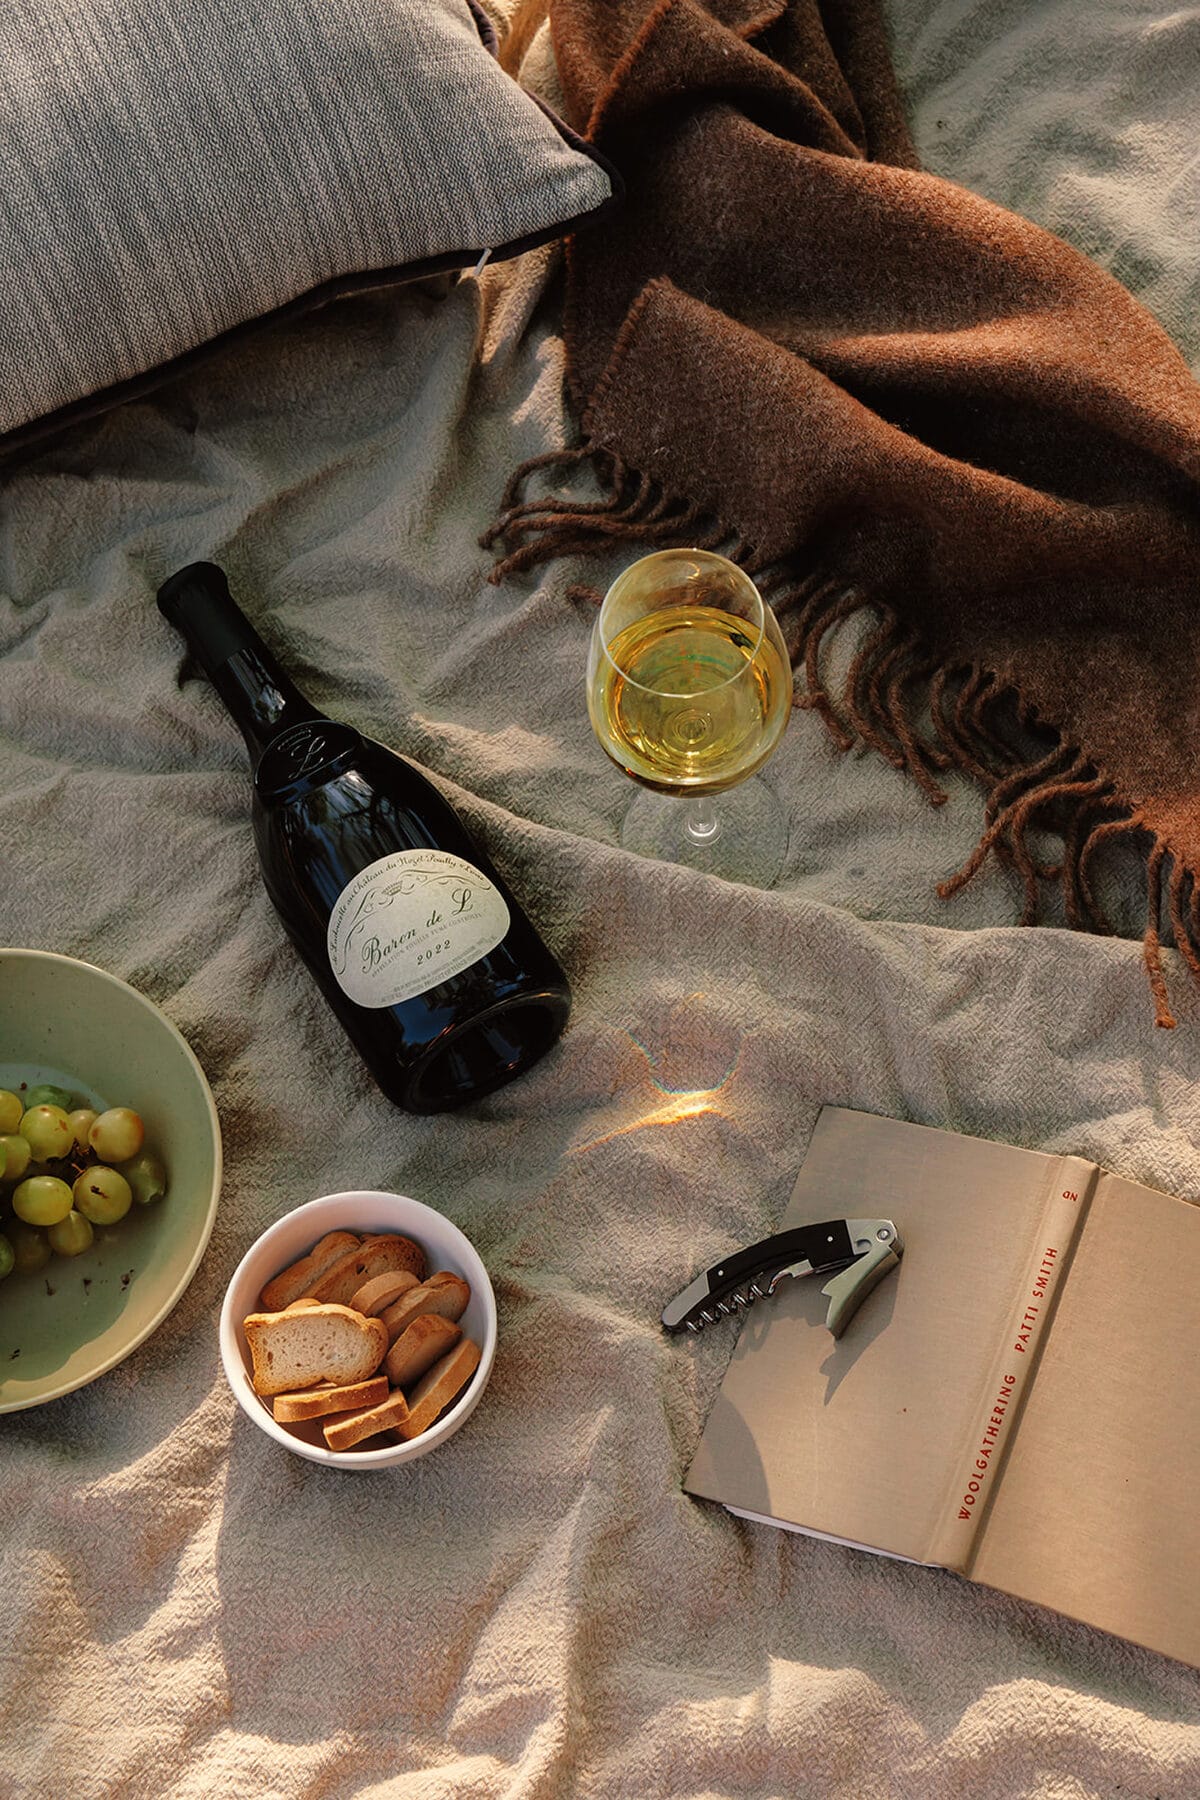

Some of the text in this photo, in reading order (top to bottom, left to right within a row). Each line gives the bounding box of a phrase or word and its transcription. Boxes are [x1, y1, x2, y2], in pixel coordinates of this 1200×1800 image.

[361, 928, 417, 974] Baron
[426, 910, 443, 927] de
[451, 888, 474, 916] L
[416, 939, 451, 966] 2022
[958, 1247, 1058, 1521] WOOLGATHERING PATTI SMITH
